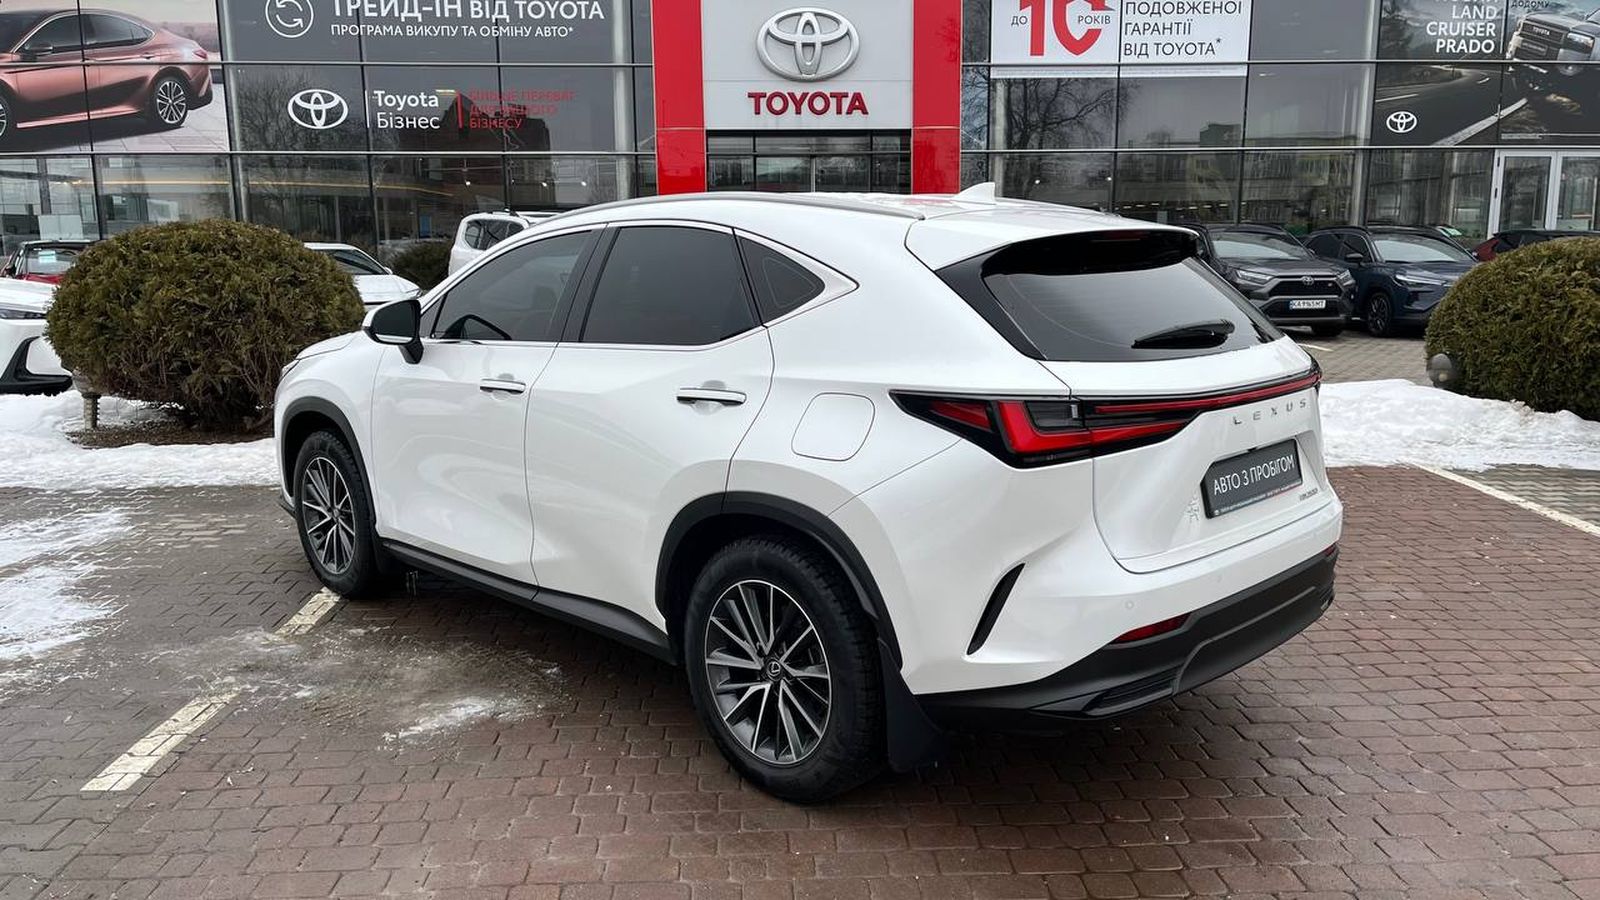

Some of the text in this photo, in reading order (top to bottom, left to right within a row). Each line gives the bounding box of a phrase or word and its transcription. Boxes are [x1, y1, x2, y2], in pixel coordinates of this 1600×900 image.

[469, 0, 510, 23] ВІД
[514, 1, 605, 19] TOYOTA
[1452, 5, 1497, 19] LAND
[1010, 15, 1028, 26] ДО
[1077, 15, 1111, 25] РОКІВ
[1124, 18, 1194, 35] ГАРАНТІЇ
[331, 24, 403, 36] ПРОГРАМА
[406, 25, 459, 37] ВИКУПУ
[461, 25, 477, 37] ТА
[480, 26, 532, 37] ОБМІНУ
[1426, 21, 1496, 37] CRUISER
[1123, 42, 1149, 58] ВІД
[1436, 38, 1495, 53] PRADO
[373, 90, 439, 111] Toyota
[747, 91, 869, 115] TOYOTA
[377, 112, 440, 129] Бізнес
[469, 118, 522, 129] БІЗНЕСУ
[1213, 472, 1241, 495] АВТО
[1249, 454, 1295, 484] ПРОБІГОМ
